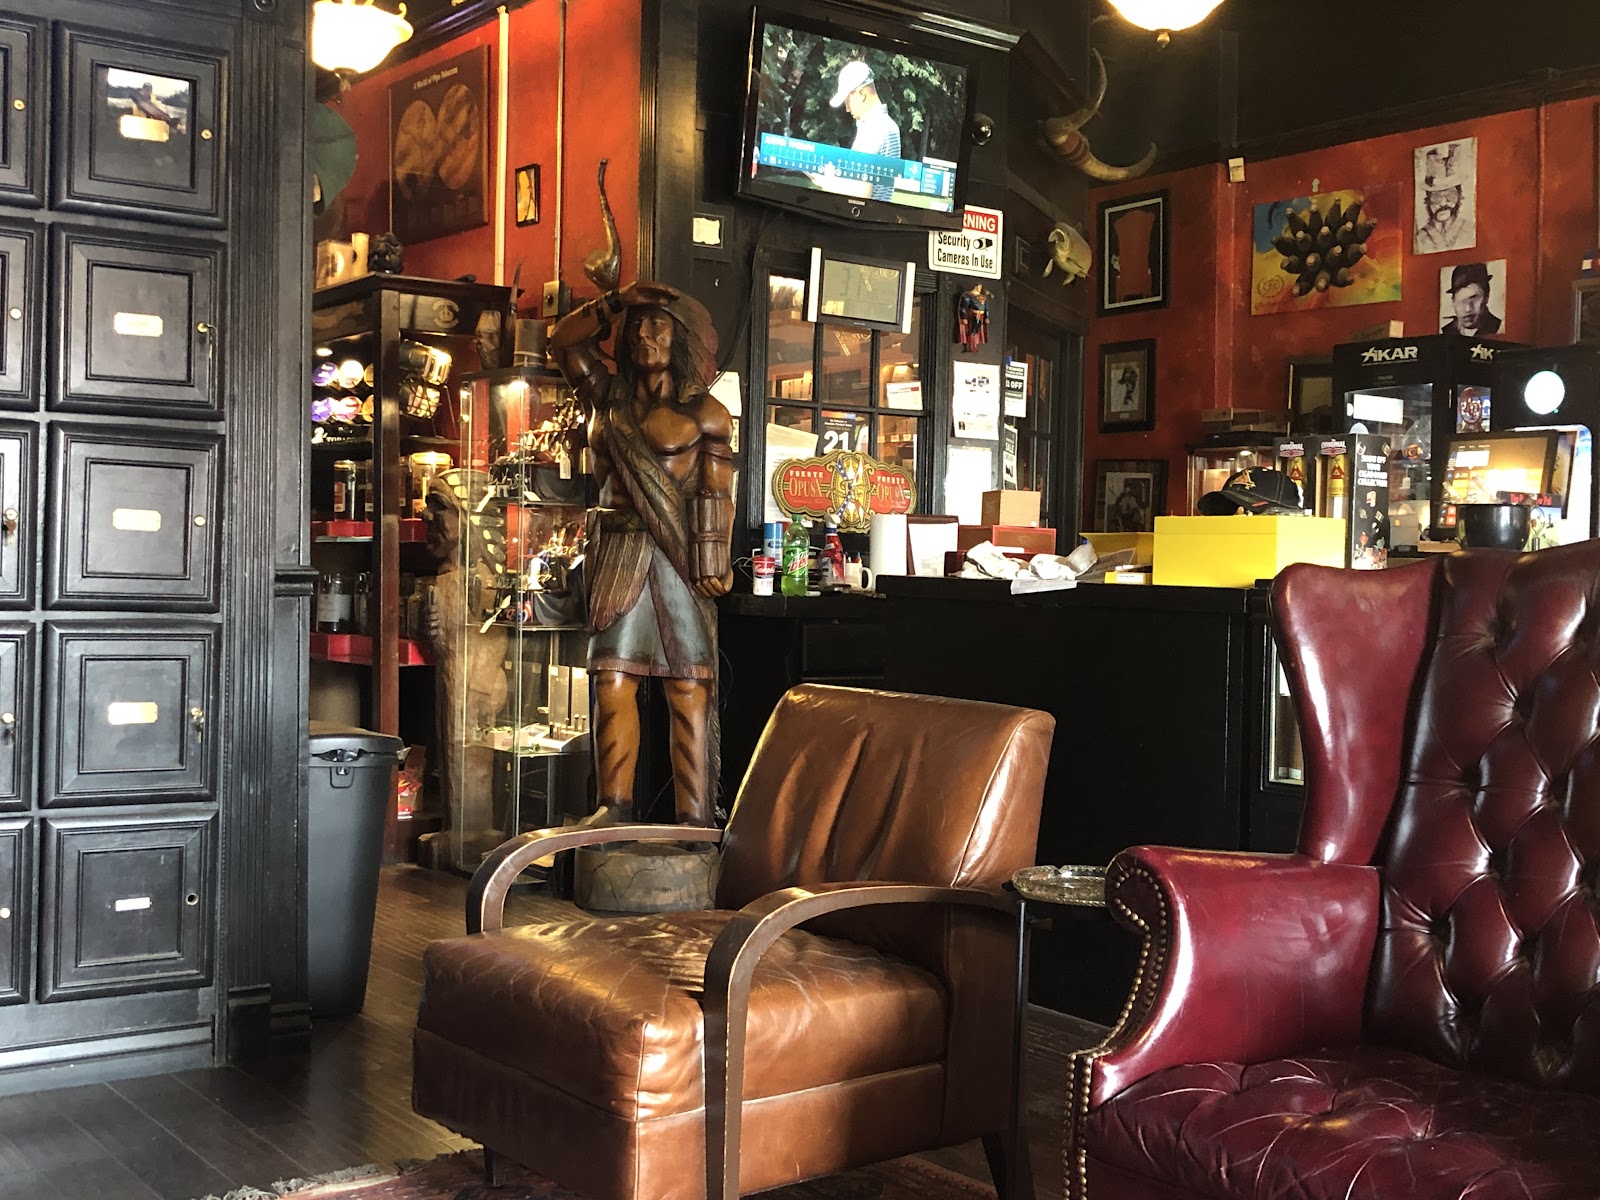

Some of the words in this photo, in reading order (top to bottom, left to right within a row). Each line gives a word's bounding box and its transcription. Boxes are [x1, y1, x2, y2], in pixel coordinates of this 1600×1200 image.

[938, 231, 971, 251] Security
[937, 248, 970, 266] Cameras
[971, 253, 979, 267] In
[980, 254, 993, 269] Use
[1010, 381, 1023, 390] OFF
[823, 430, 852, 454] 21
[1280, 442, 1304, 451] ORIGINAL
[1321, 441, 1346, 449] ORIGINAL
[1357, 478, 1388, 487] COLLECTION
